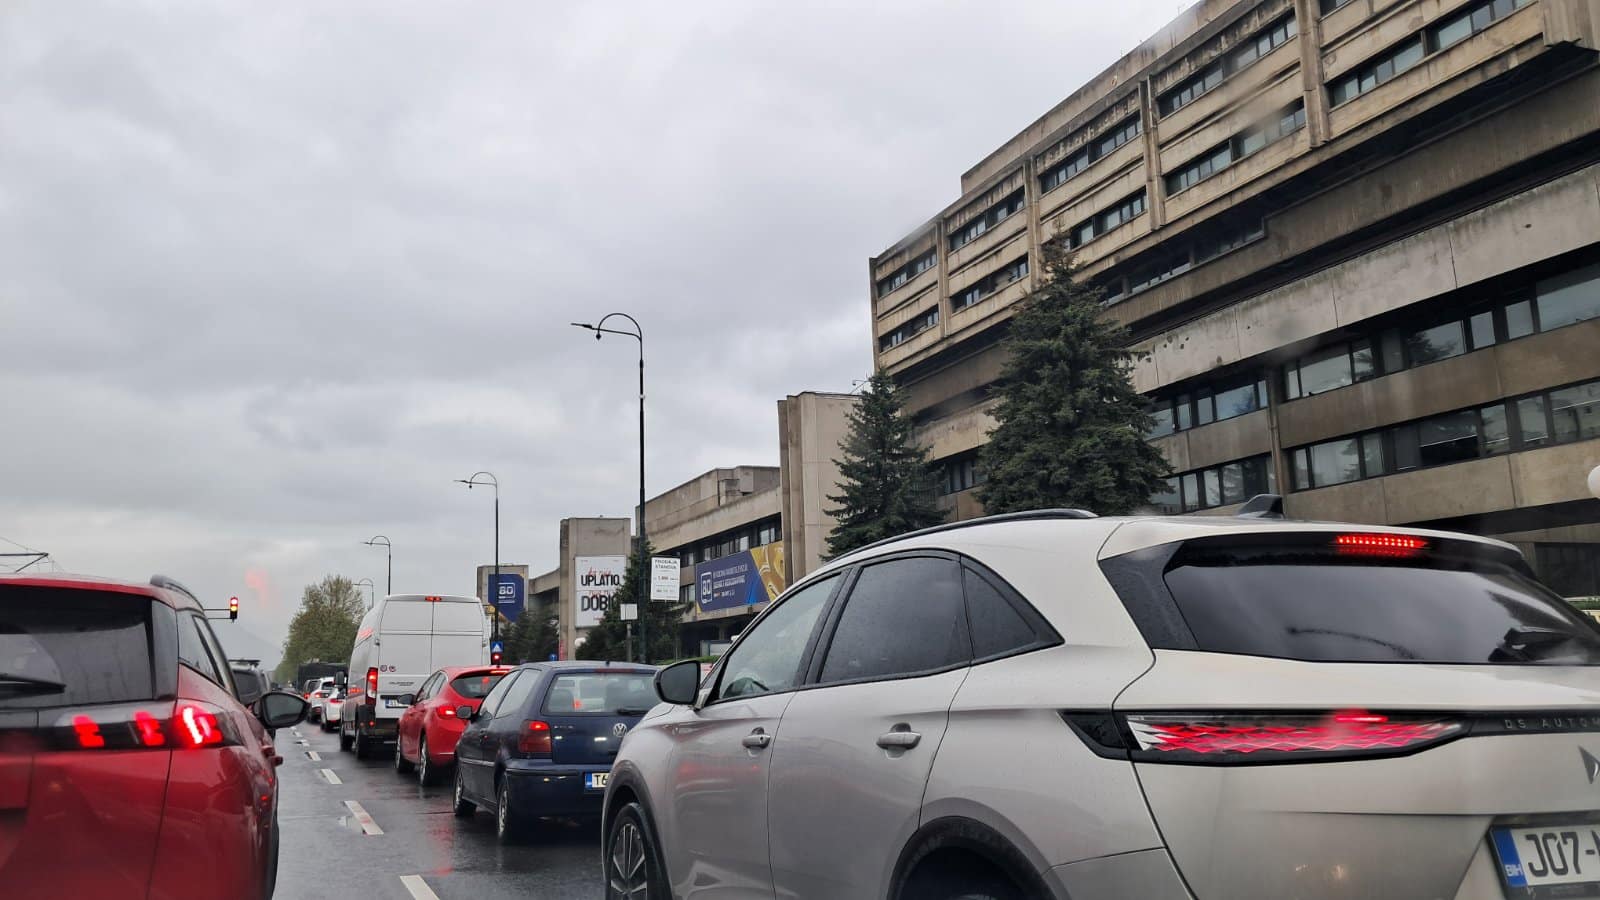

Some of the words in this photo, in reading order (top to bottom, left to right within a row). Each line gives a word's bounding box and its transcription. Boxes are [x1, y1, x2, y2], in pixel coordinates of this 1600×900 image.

[581, 574, 620, 586] UPLATIO
[498, 586, 514, 595] 80
[1504, 719, 1527, 729] DS
[1505, 864, 1523, 877] BIH
